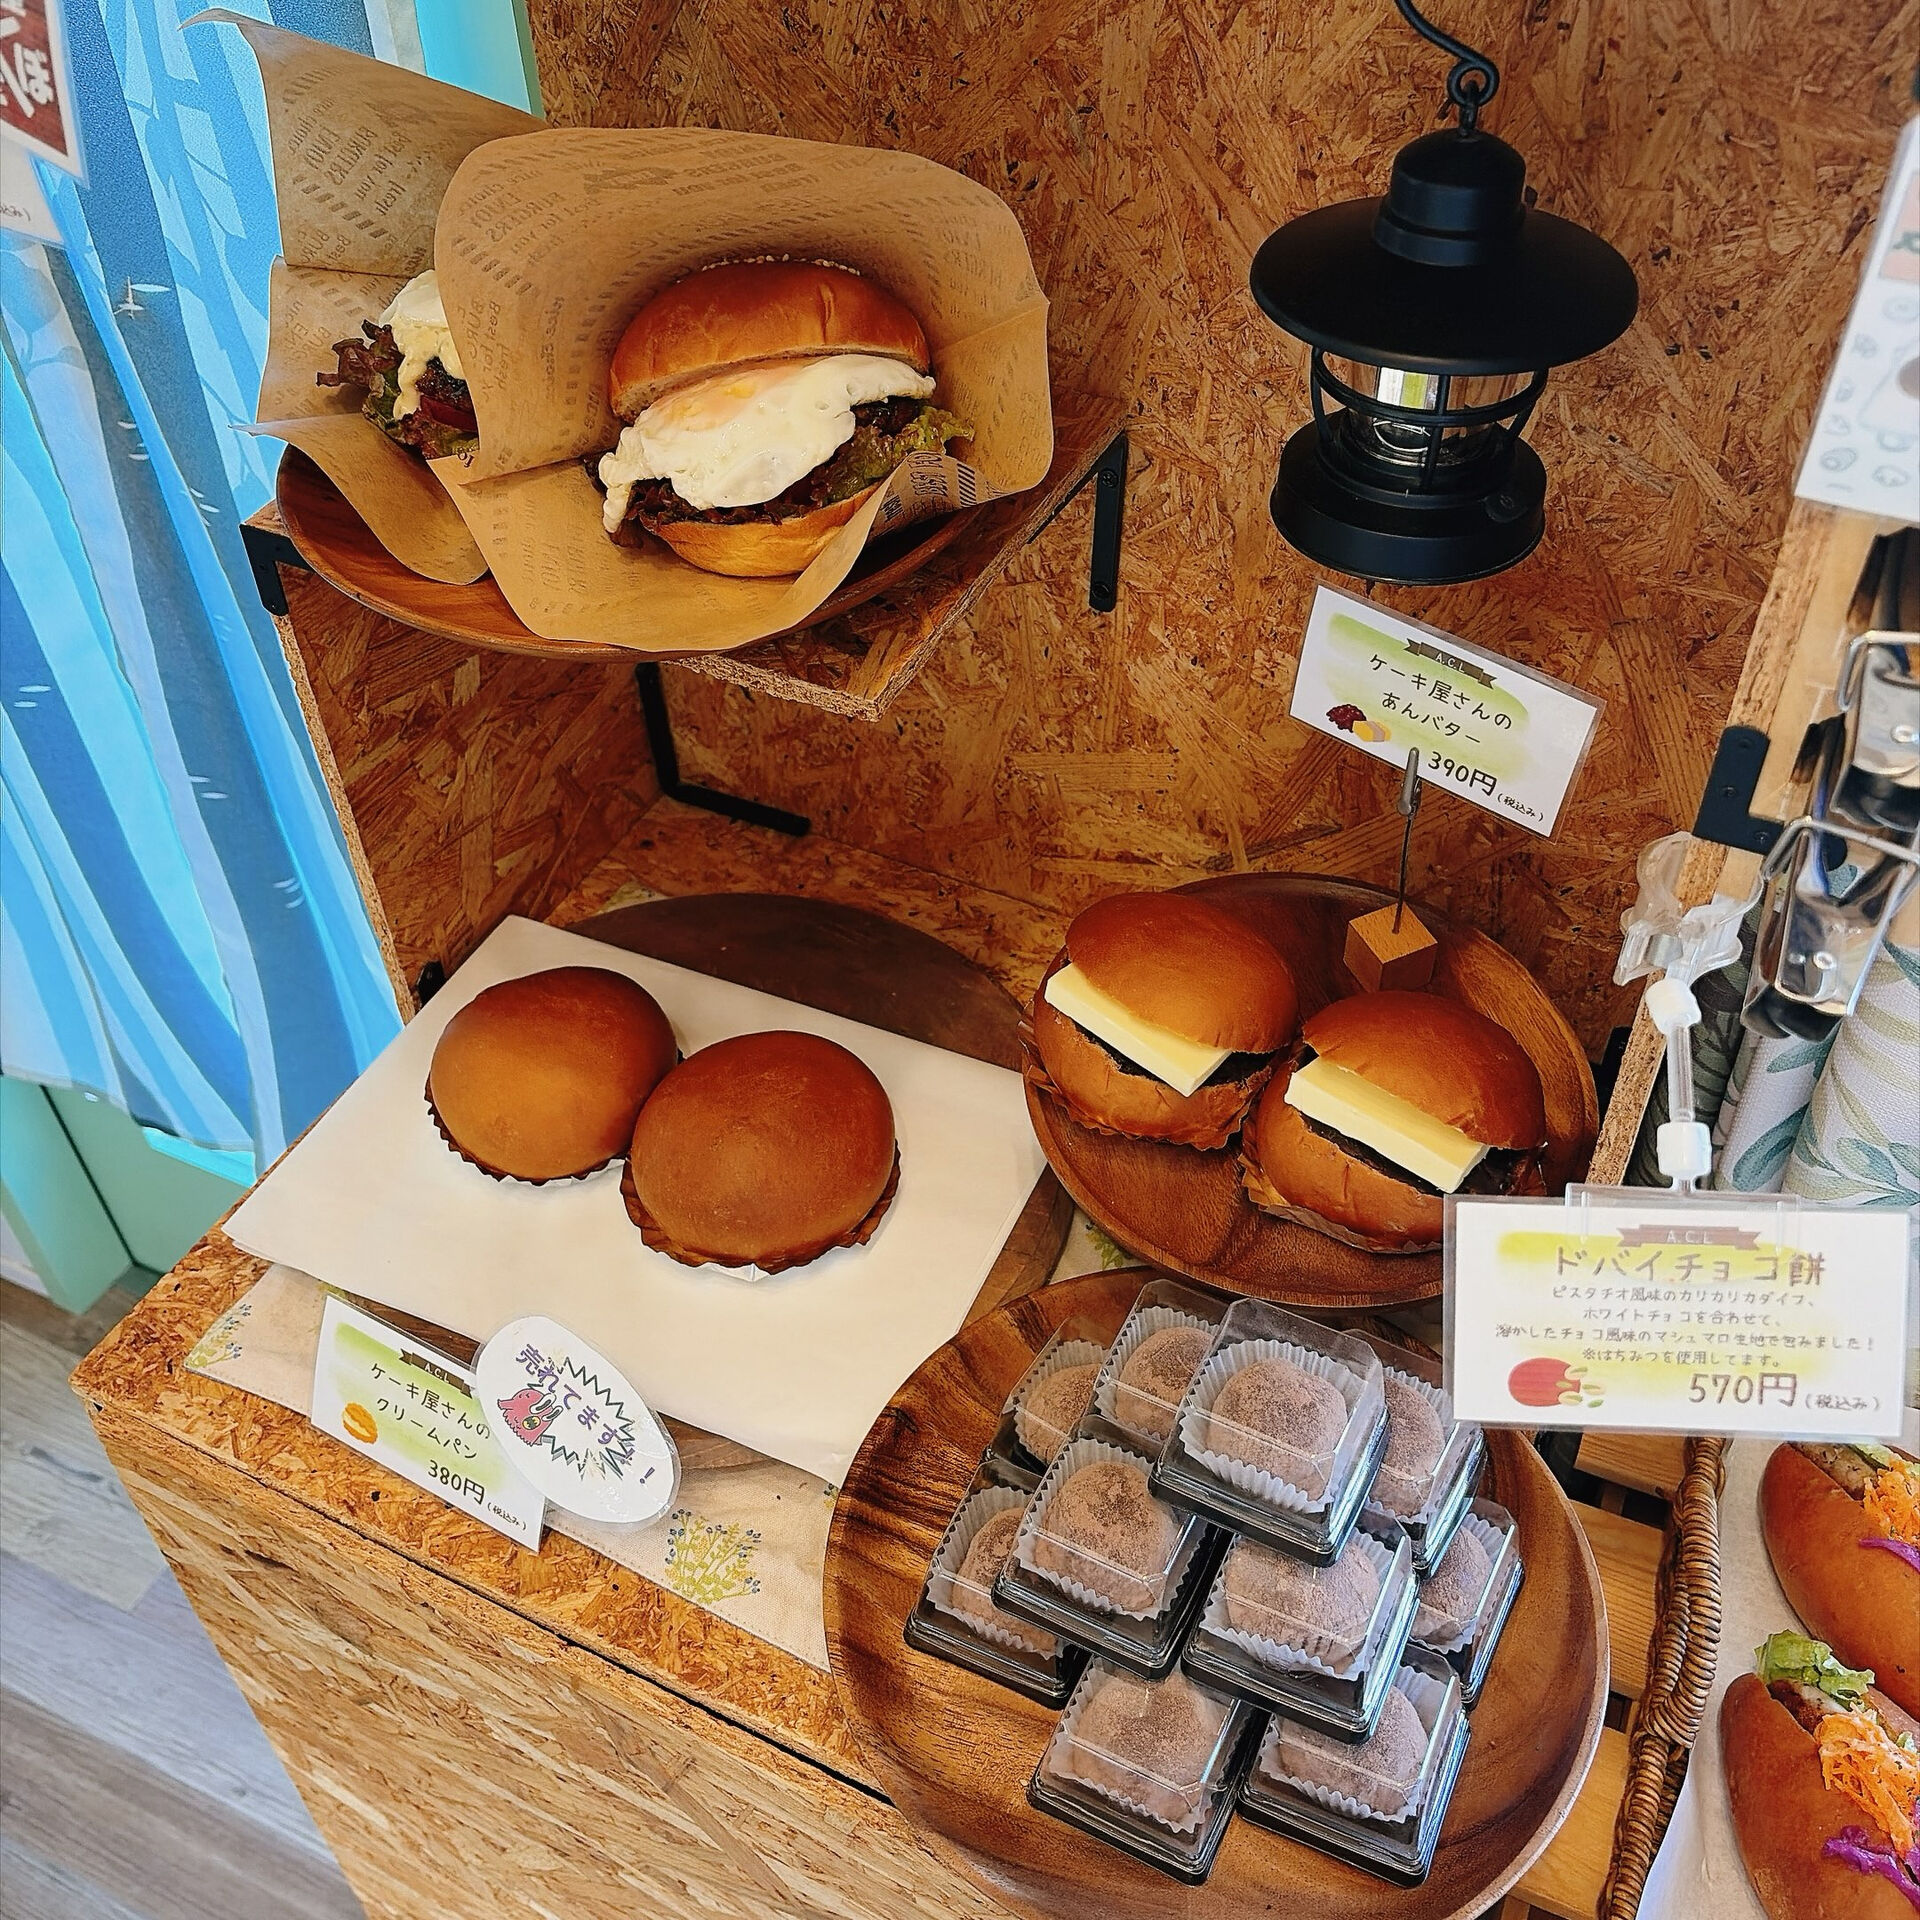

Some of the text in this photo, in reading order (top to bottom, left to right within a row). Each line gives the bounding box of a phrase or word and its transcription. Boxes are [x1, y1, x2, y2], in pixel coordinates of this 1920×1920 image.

[1435, 652, 1465, 674] A.C.L
[1369, 653, 1513, 731] ケーキ屋さんの
[1381, 691, 1481, 744] あんバター
[1427, 750, 1545, 822] 390円 （税込み）
[1666, 1229, 1713, 1245] A.C.L
[1556, 1246, 1826, 1288] ドバイチョコ餅
[1552, 1285, 1815, 1308] ピスタチオ風味のカリカリカダイフ、
[1495, 1322, 1874, 1352] 溶かしたチョコ風味のマシュマロ生地で包みました！
[1583, 1306, 1781, 1328] ホワイトチョコを合わせて、
[424, 1362, 450, 1384] A.C.L
[1582, 1347, 1781, 1368] ※はちみつを使用してます。
[371, 1362, 491, 1441] ケーキ屋さんの
[1689, 1371, 1880, 1411] 570円 （税込み）
[376, 1398, 478, 1461] クリームパン
[428, 1459, 527, 1532] 380円 （税込み）
